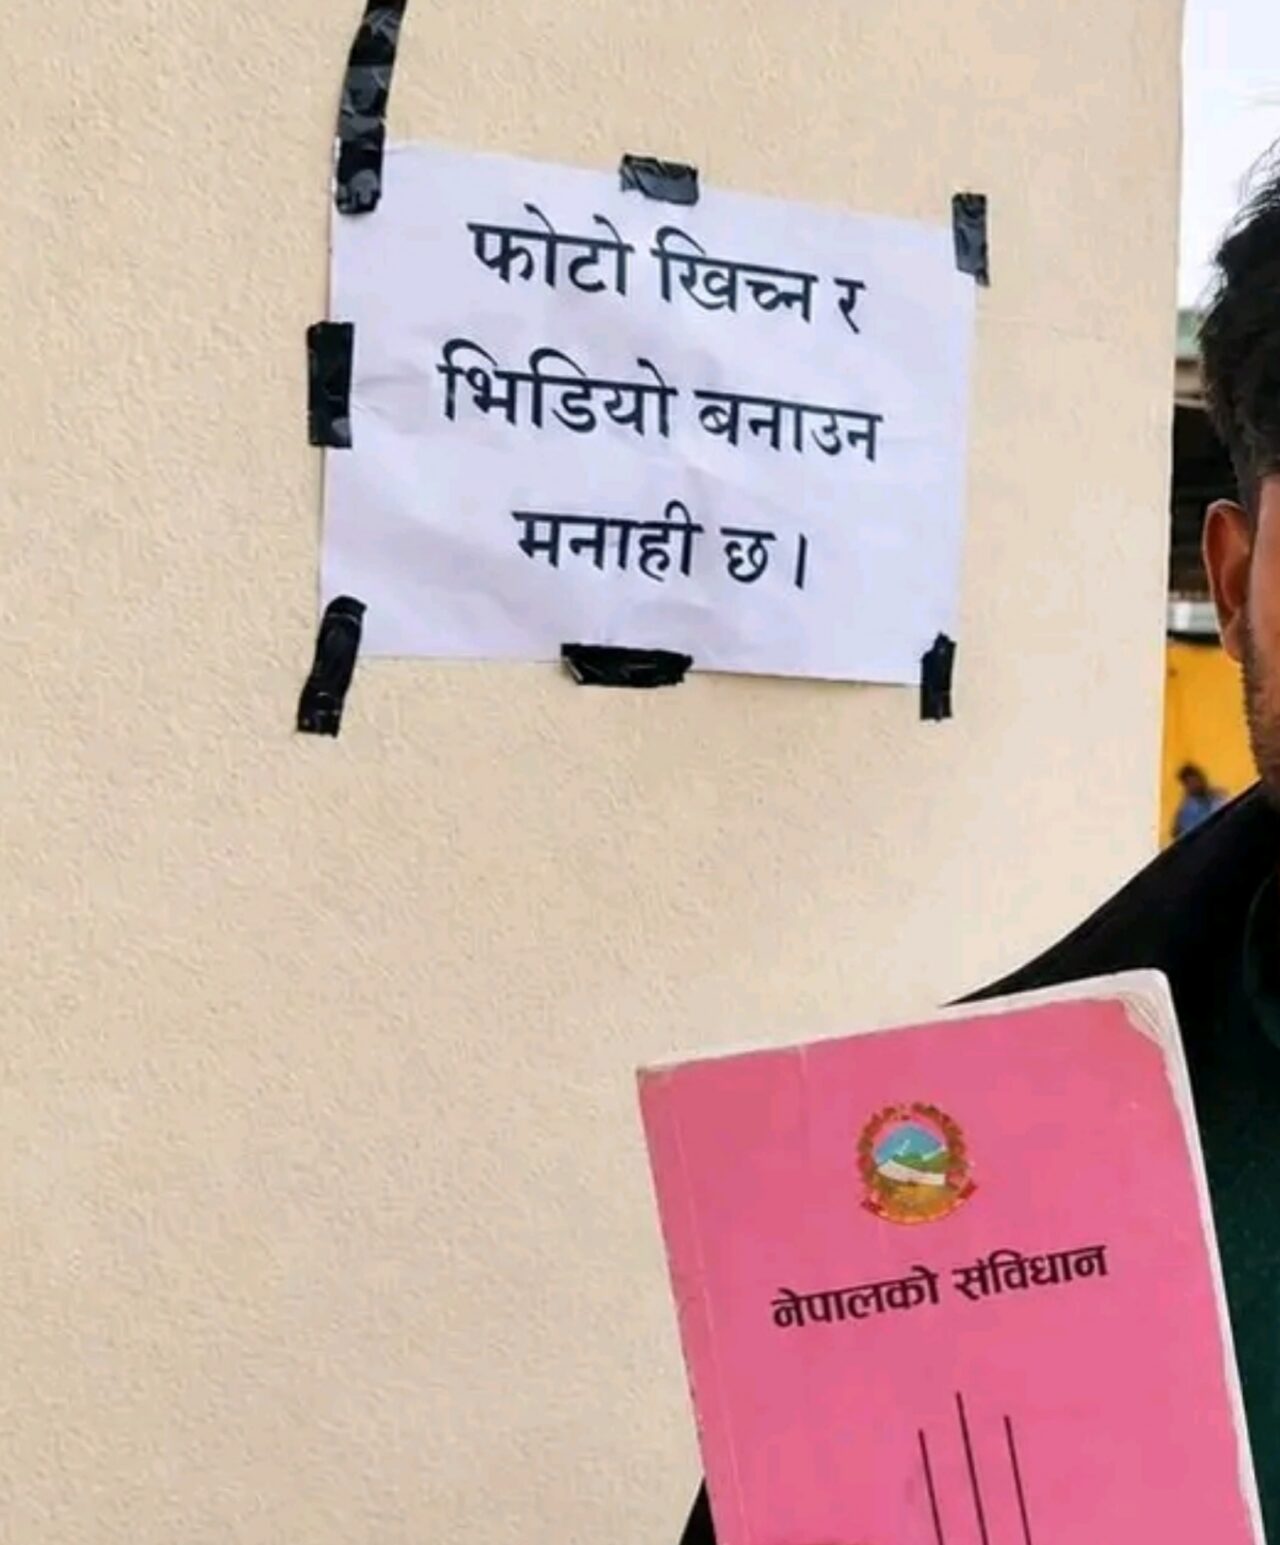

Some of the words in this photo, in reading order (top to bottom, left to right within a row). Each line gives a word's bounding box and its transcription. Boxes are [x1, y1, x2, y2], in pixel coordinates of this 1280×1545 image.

[466, 203, 635, 297] फोटो
[833, 277, 866, 335] र
[436, 337, 680, 438] भिडियो
[692, 389, 884, 462] बनाउन
[511, 499, 706, 583] मनाही
[770, 1264, 940, 1328] नेपालको
[951, 1244, 1108, 1301] संविधान
